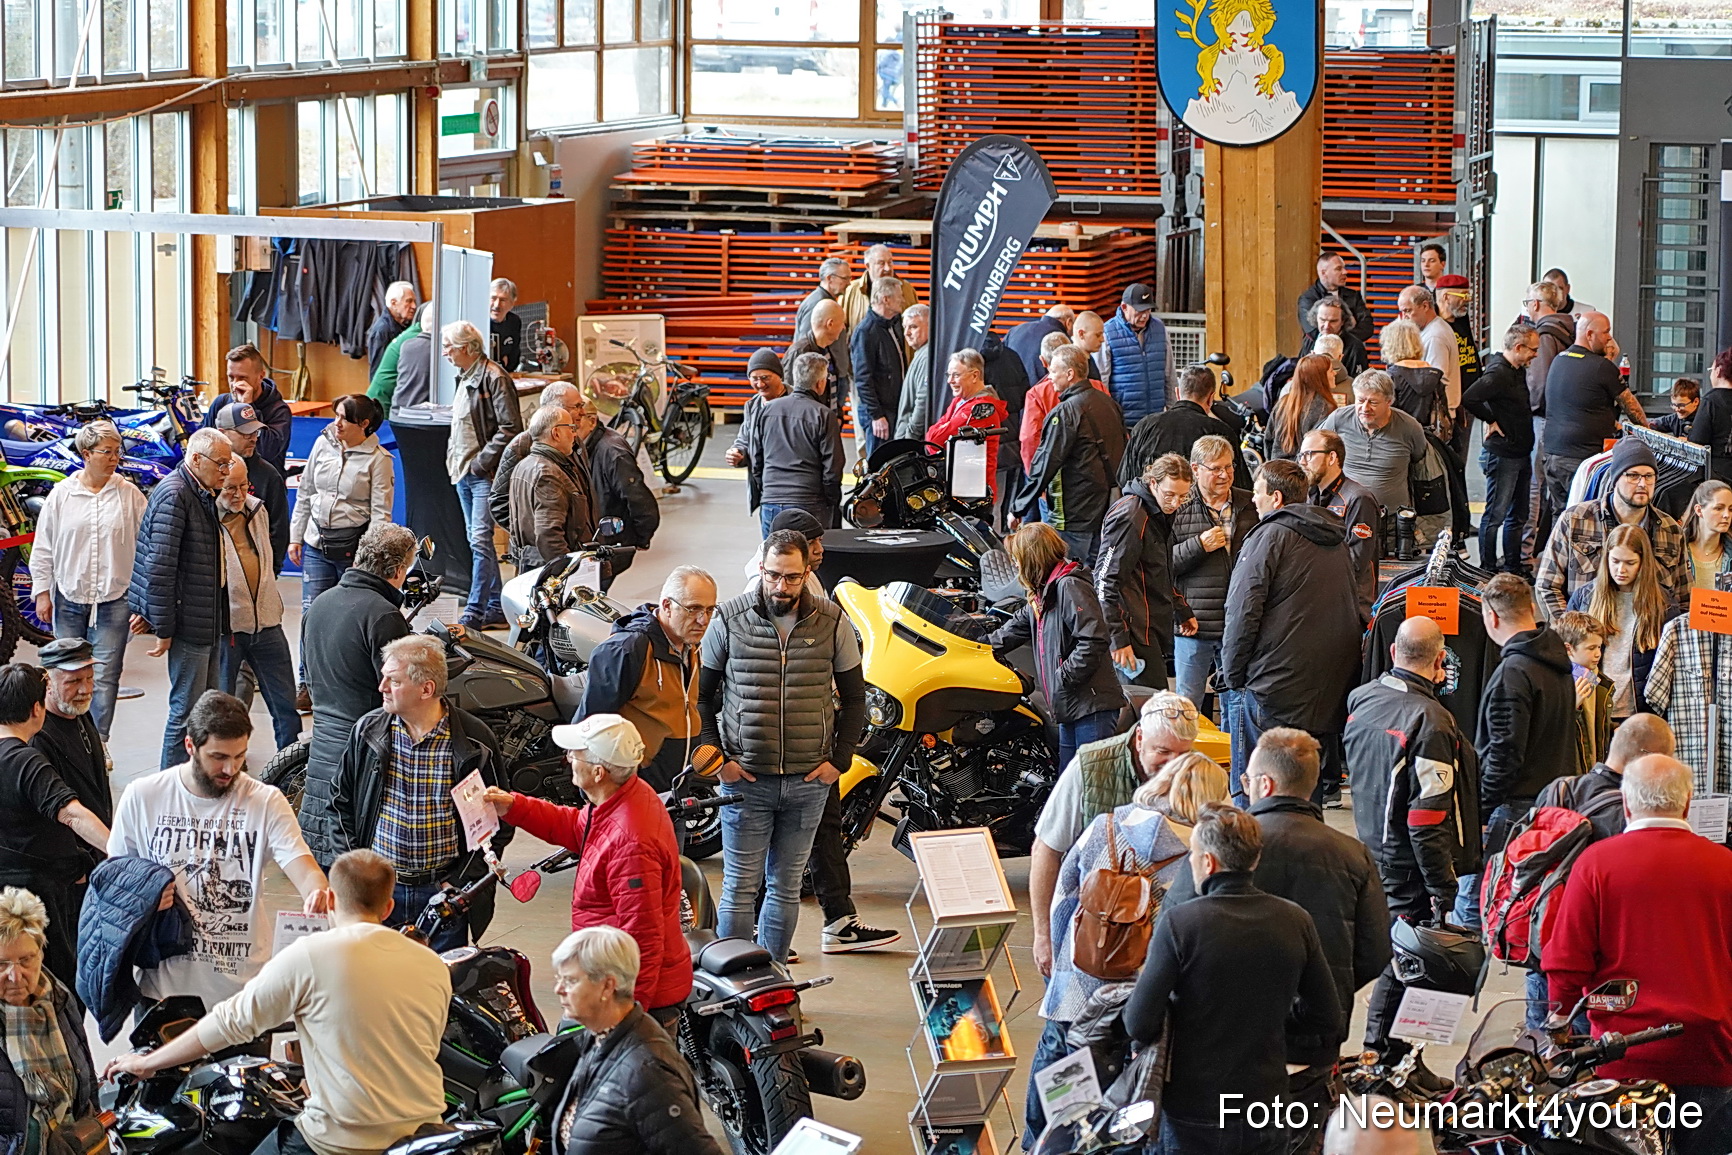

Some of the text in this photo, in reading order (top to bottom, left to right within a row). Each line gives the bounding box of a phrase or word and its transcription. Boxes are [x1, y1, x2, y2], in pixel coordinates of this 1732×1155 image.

[943, 181, 1008, 291] TRIUMPH
[970, 236, 1022, 334] NÜRNBERG
[121, 428, 155, 443] MEYER
[29, 457, 71, 471] MEYER
[157, 815, 201, 829] LEGENDARY
[204, 818, 223, 830] ROAD
[202, 938, 253, 958] ETERNITY
